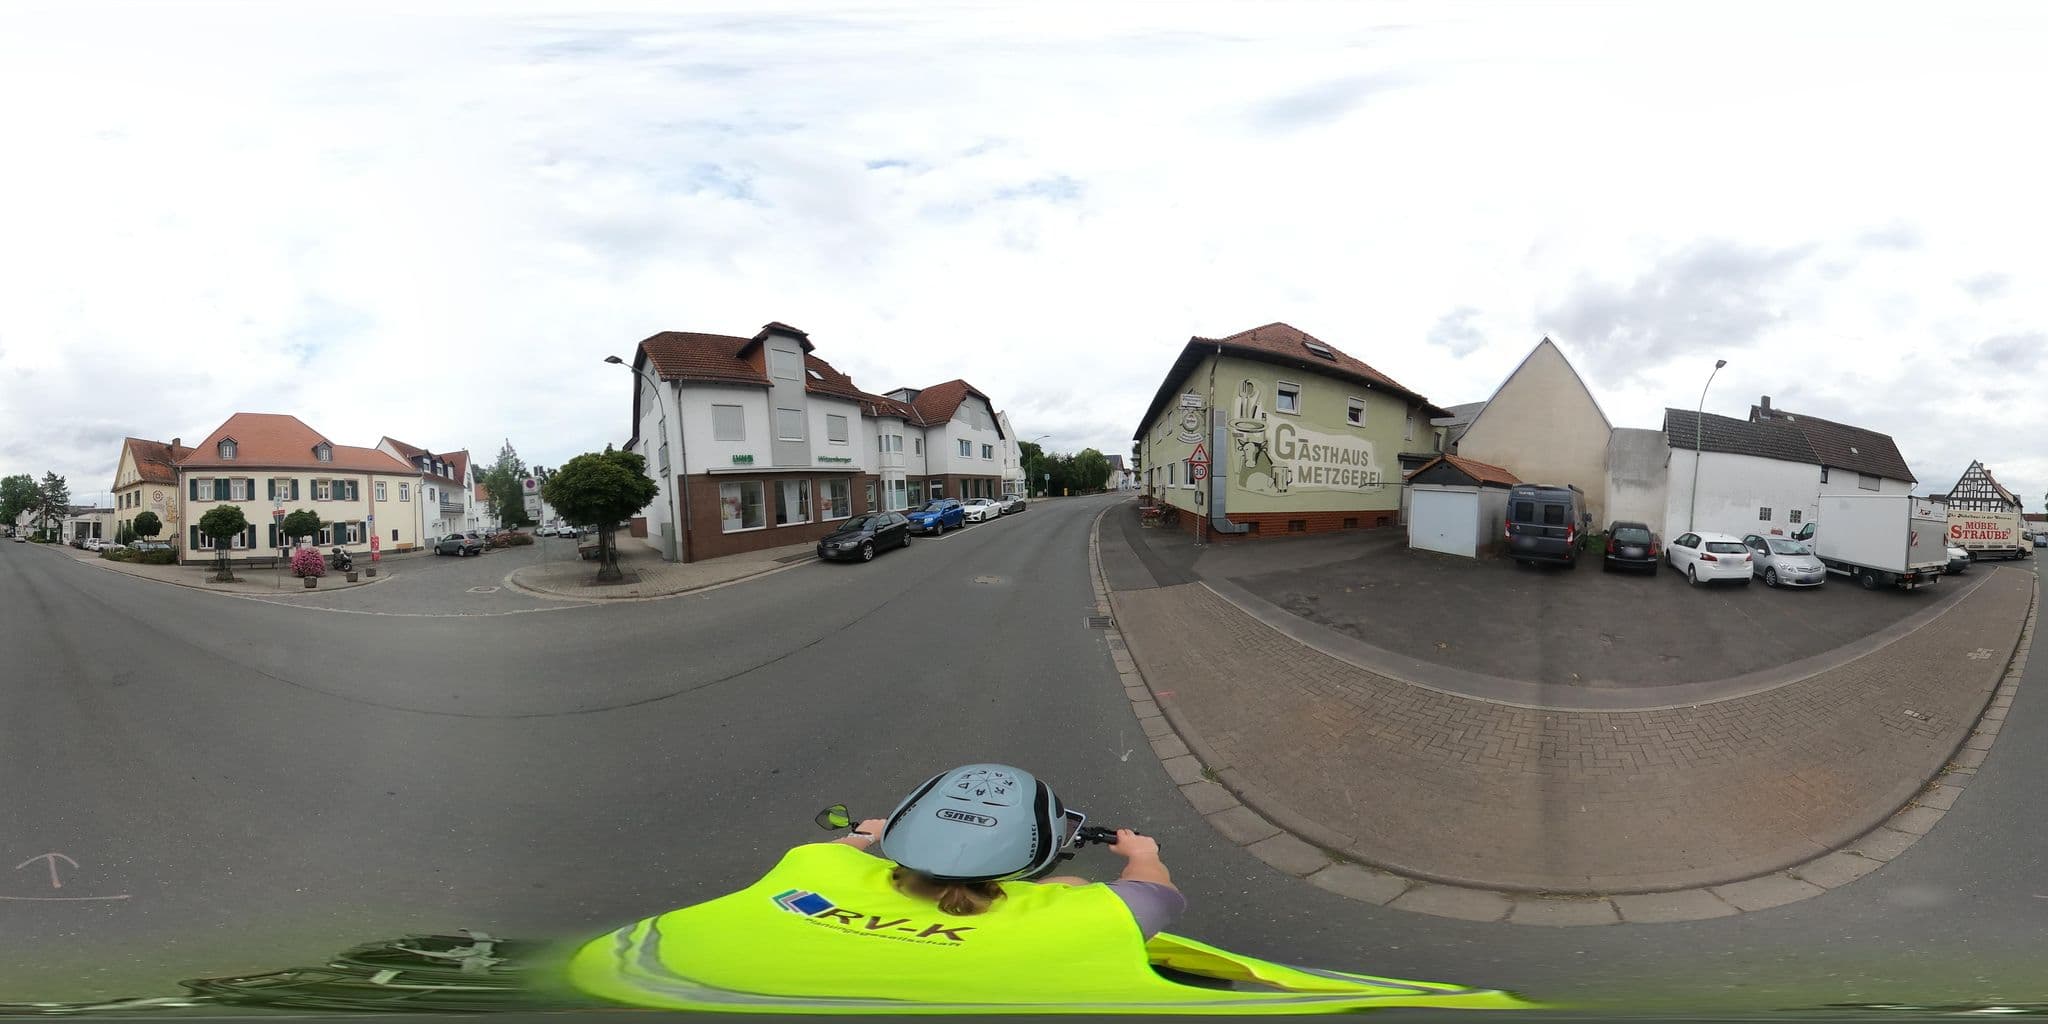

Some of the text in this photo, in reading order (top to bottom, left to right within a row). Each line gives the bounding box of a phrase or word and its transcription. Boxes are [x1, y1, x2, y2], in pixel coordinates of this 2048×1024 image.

[1275, 423, 1369, 467] GASTHAUS
[1195, 468, 1204, 476] 30
[1298, 465, 1380, 487] METZGEREI
[1951, 525, 2010, 540] STRAUBE
[944, 811, 990, 825] ABUS
[816, 908, 977, 942] RV-K
